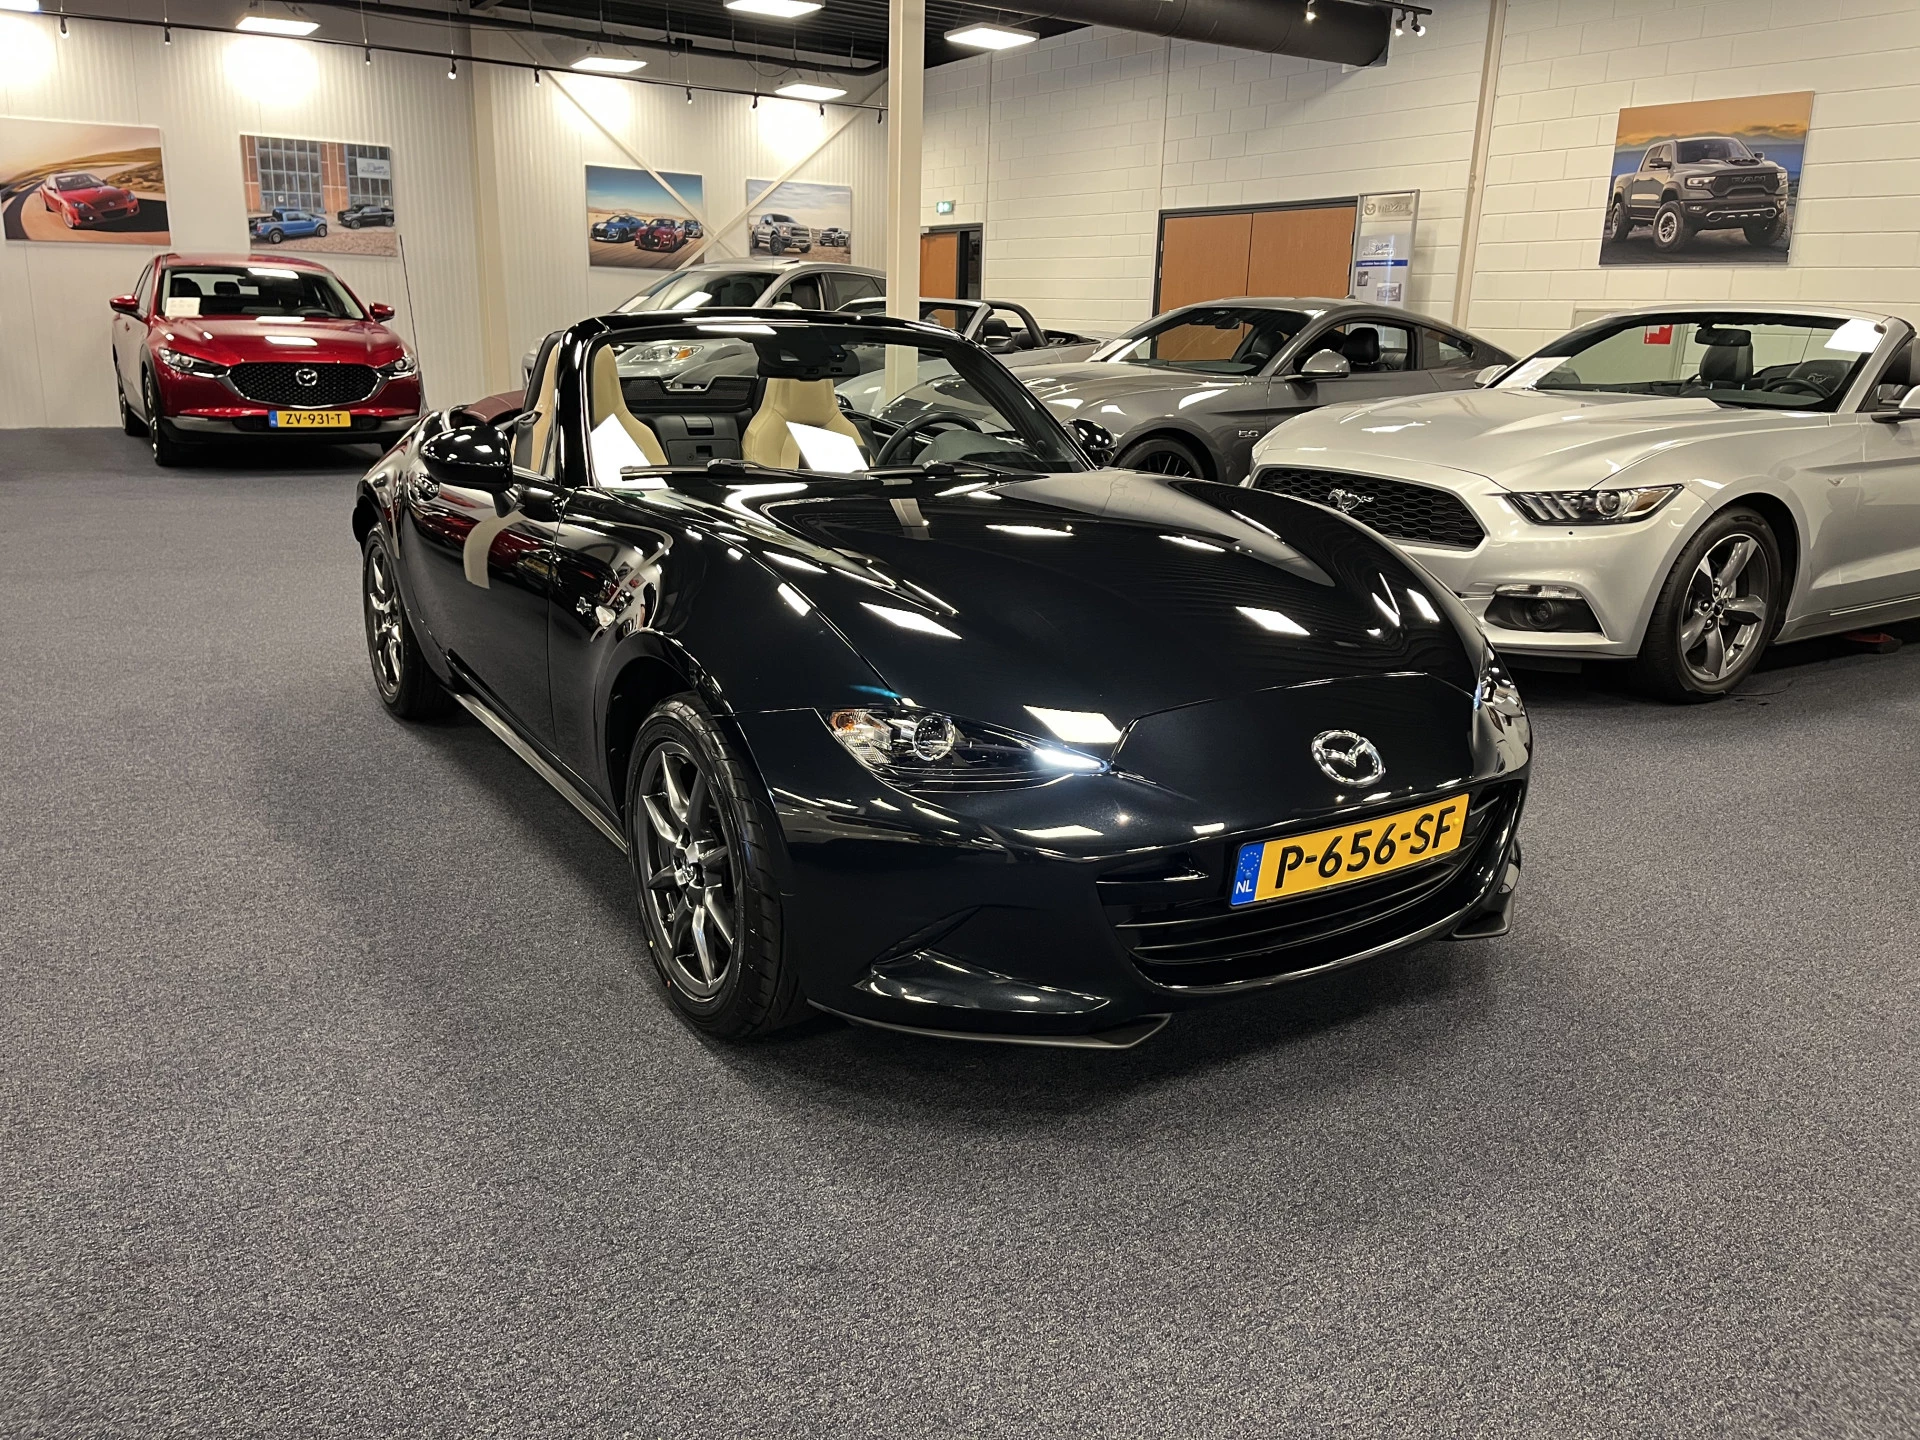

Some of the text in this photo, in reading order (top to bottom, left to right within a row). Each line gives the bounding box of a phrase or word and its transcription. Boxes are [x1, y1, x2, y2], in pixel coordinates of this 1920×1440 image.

[285, 413, 342, 425] ZV-931-T
[1274, 805, 1457, 889] P-656-SF
[1235, 880, 1253, 894] NL
